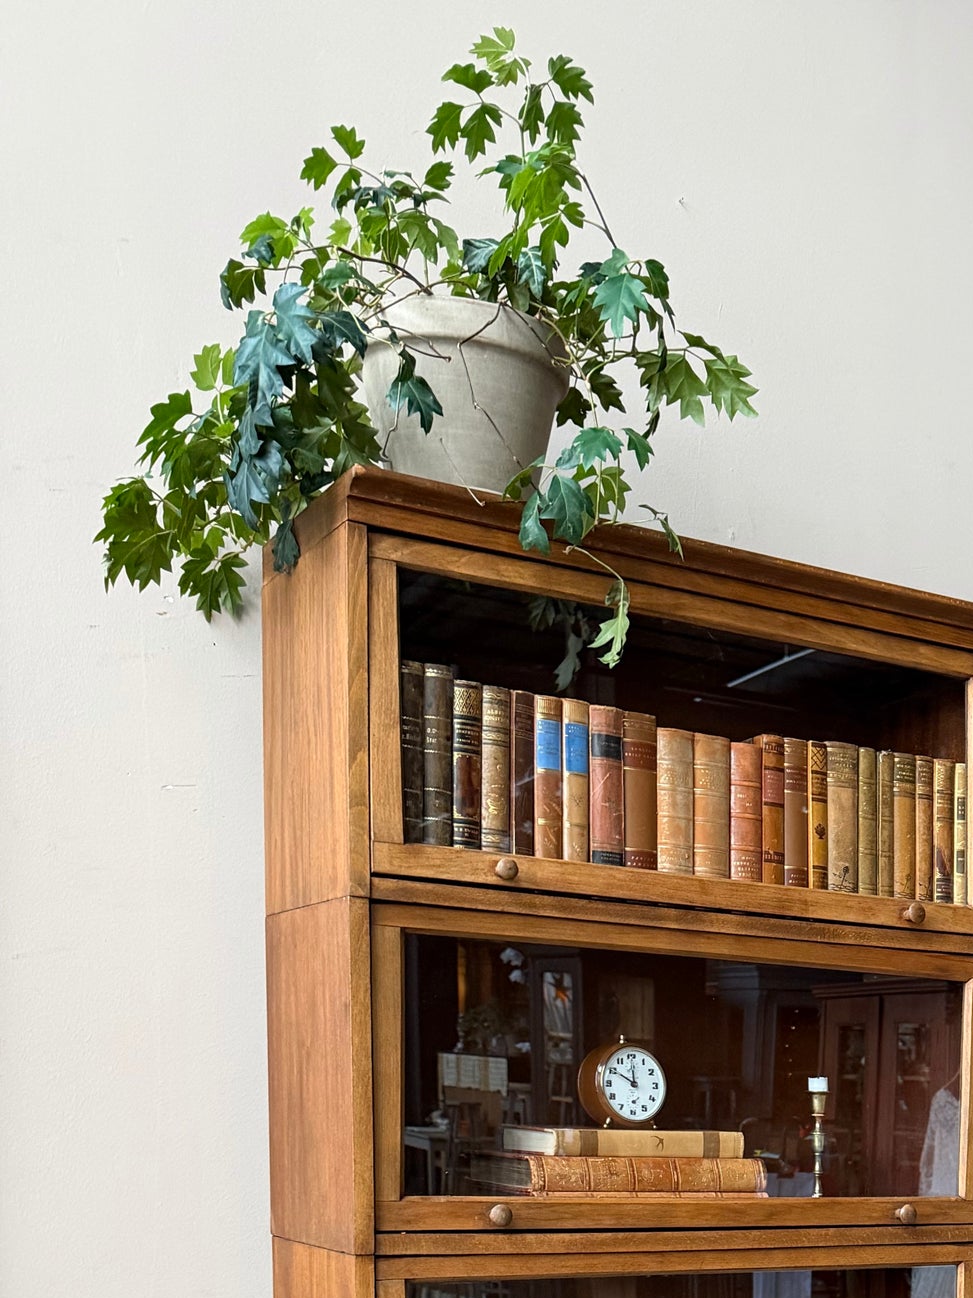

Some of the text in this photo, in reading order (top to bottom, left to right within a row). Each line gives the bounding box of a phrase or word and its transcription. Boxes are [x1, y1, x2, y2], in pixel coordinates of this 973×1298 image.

[617, 1057, 623, 1065] 11
[642, 1058, 645, 1066] 1
[652, 1082, 659, 1090] 3
